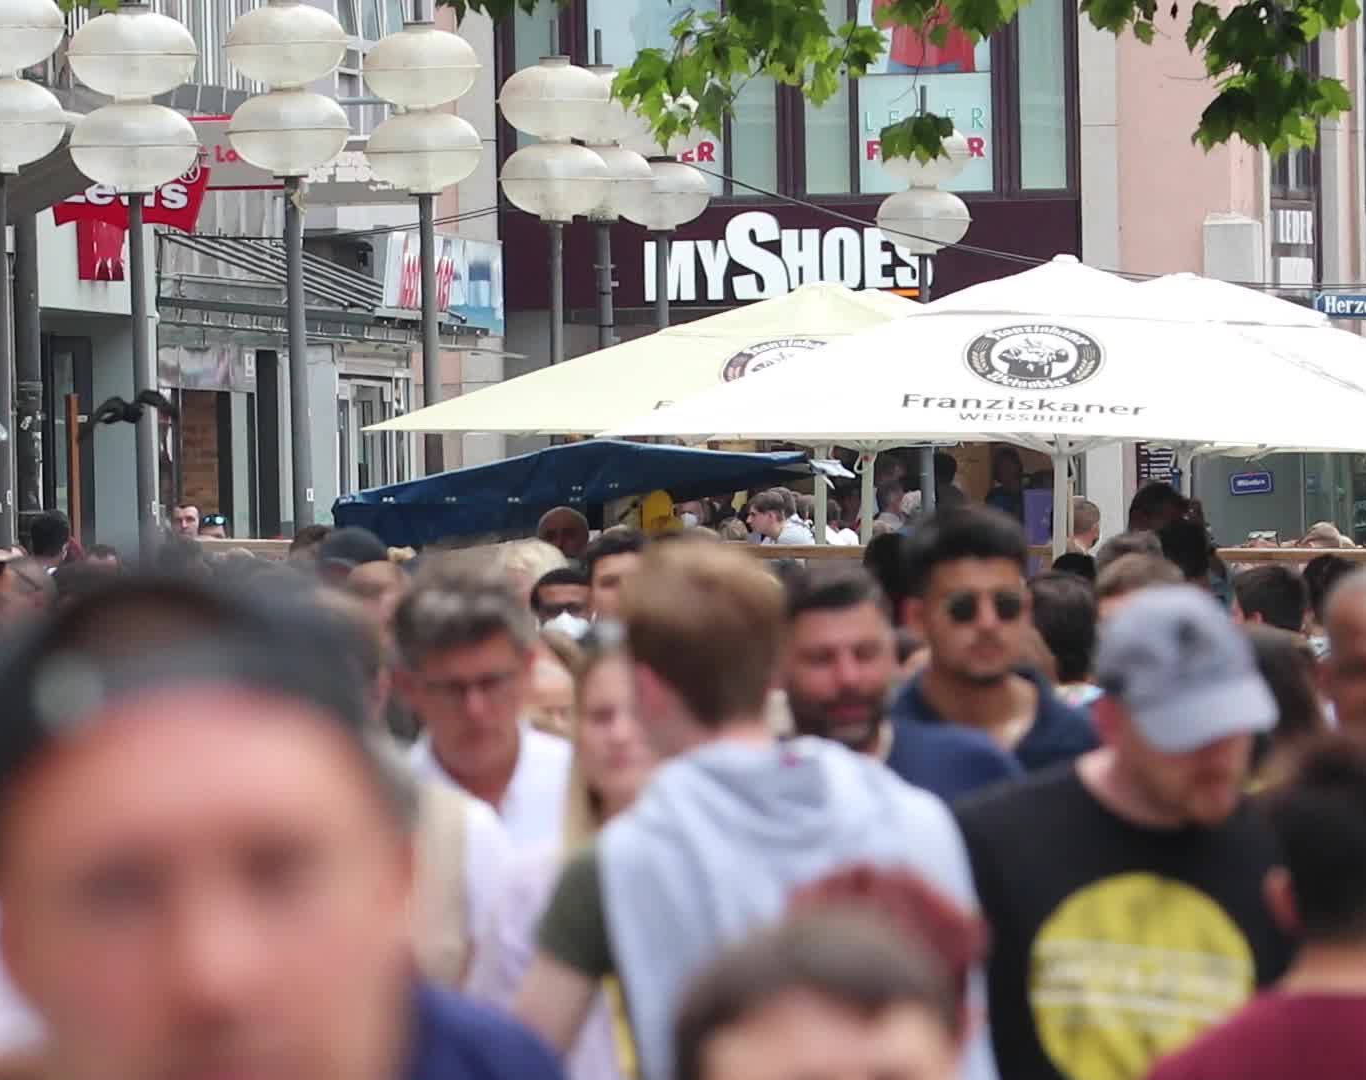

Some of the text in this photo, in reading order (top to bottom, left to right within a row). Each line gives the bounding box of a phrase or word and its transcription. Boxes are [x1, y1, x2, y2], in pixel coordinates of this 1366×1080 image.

[643, 210, 934, 302] MYSHOES
[901, 394, 1148, 417] Franziskaner
[958, 412, 1085, 424] WEISSBIER
